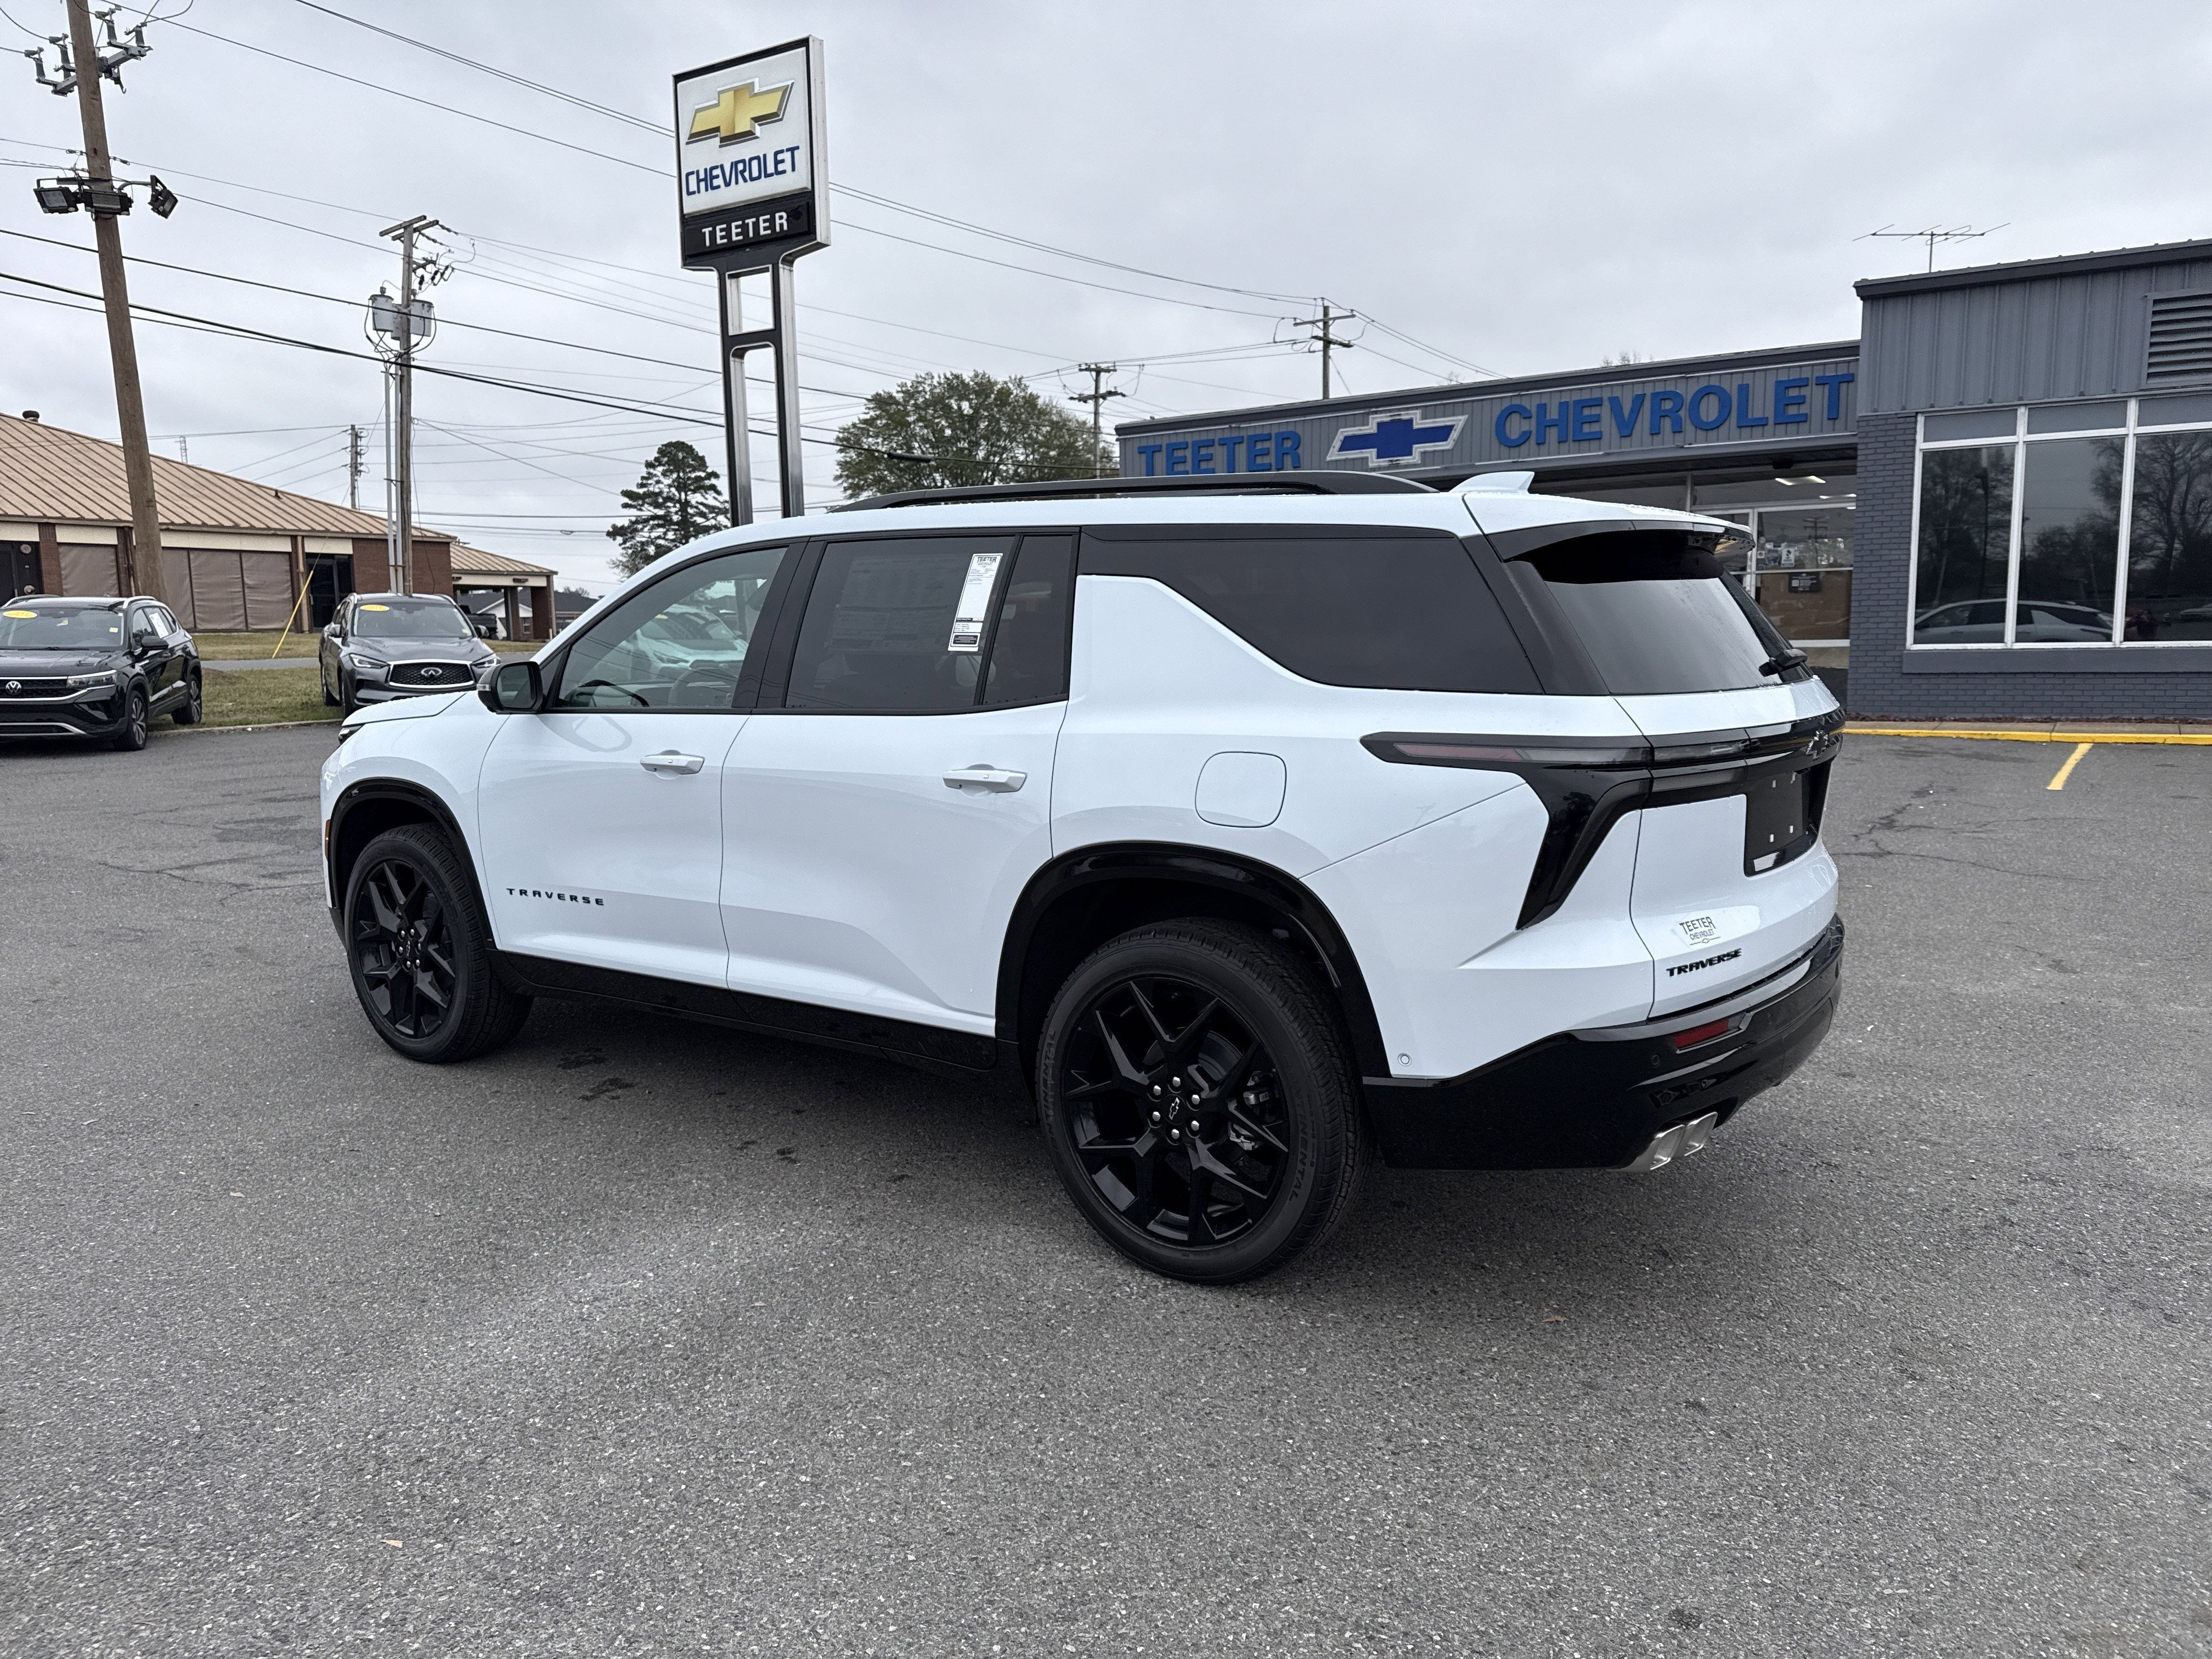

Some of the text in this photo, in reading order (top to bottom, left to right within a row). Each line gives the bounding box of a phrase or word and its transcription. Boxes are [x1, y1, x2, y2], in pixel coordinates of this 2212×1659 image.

[685, 145, 800, 196] CHEVROLET
[702, 212, 788, 247] TEETER
[1137, 373, 1854, 477] TEETER CHEVROLET
[506, 888, 604, 906] TRAVERSE
[1679, 916, 1716, 935] TEETER
[1690, 928, 1715, 940] CHEVROLET
[1666, 947, 1742, 977] TRAVERSE
